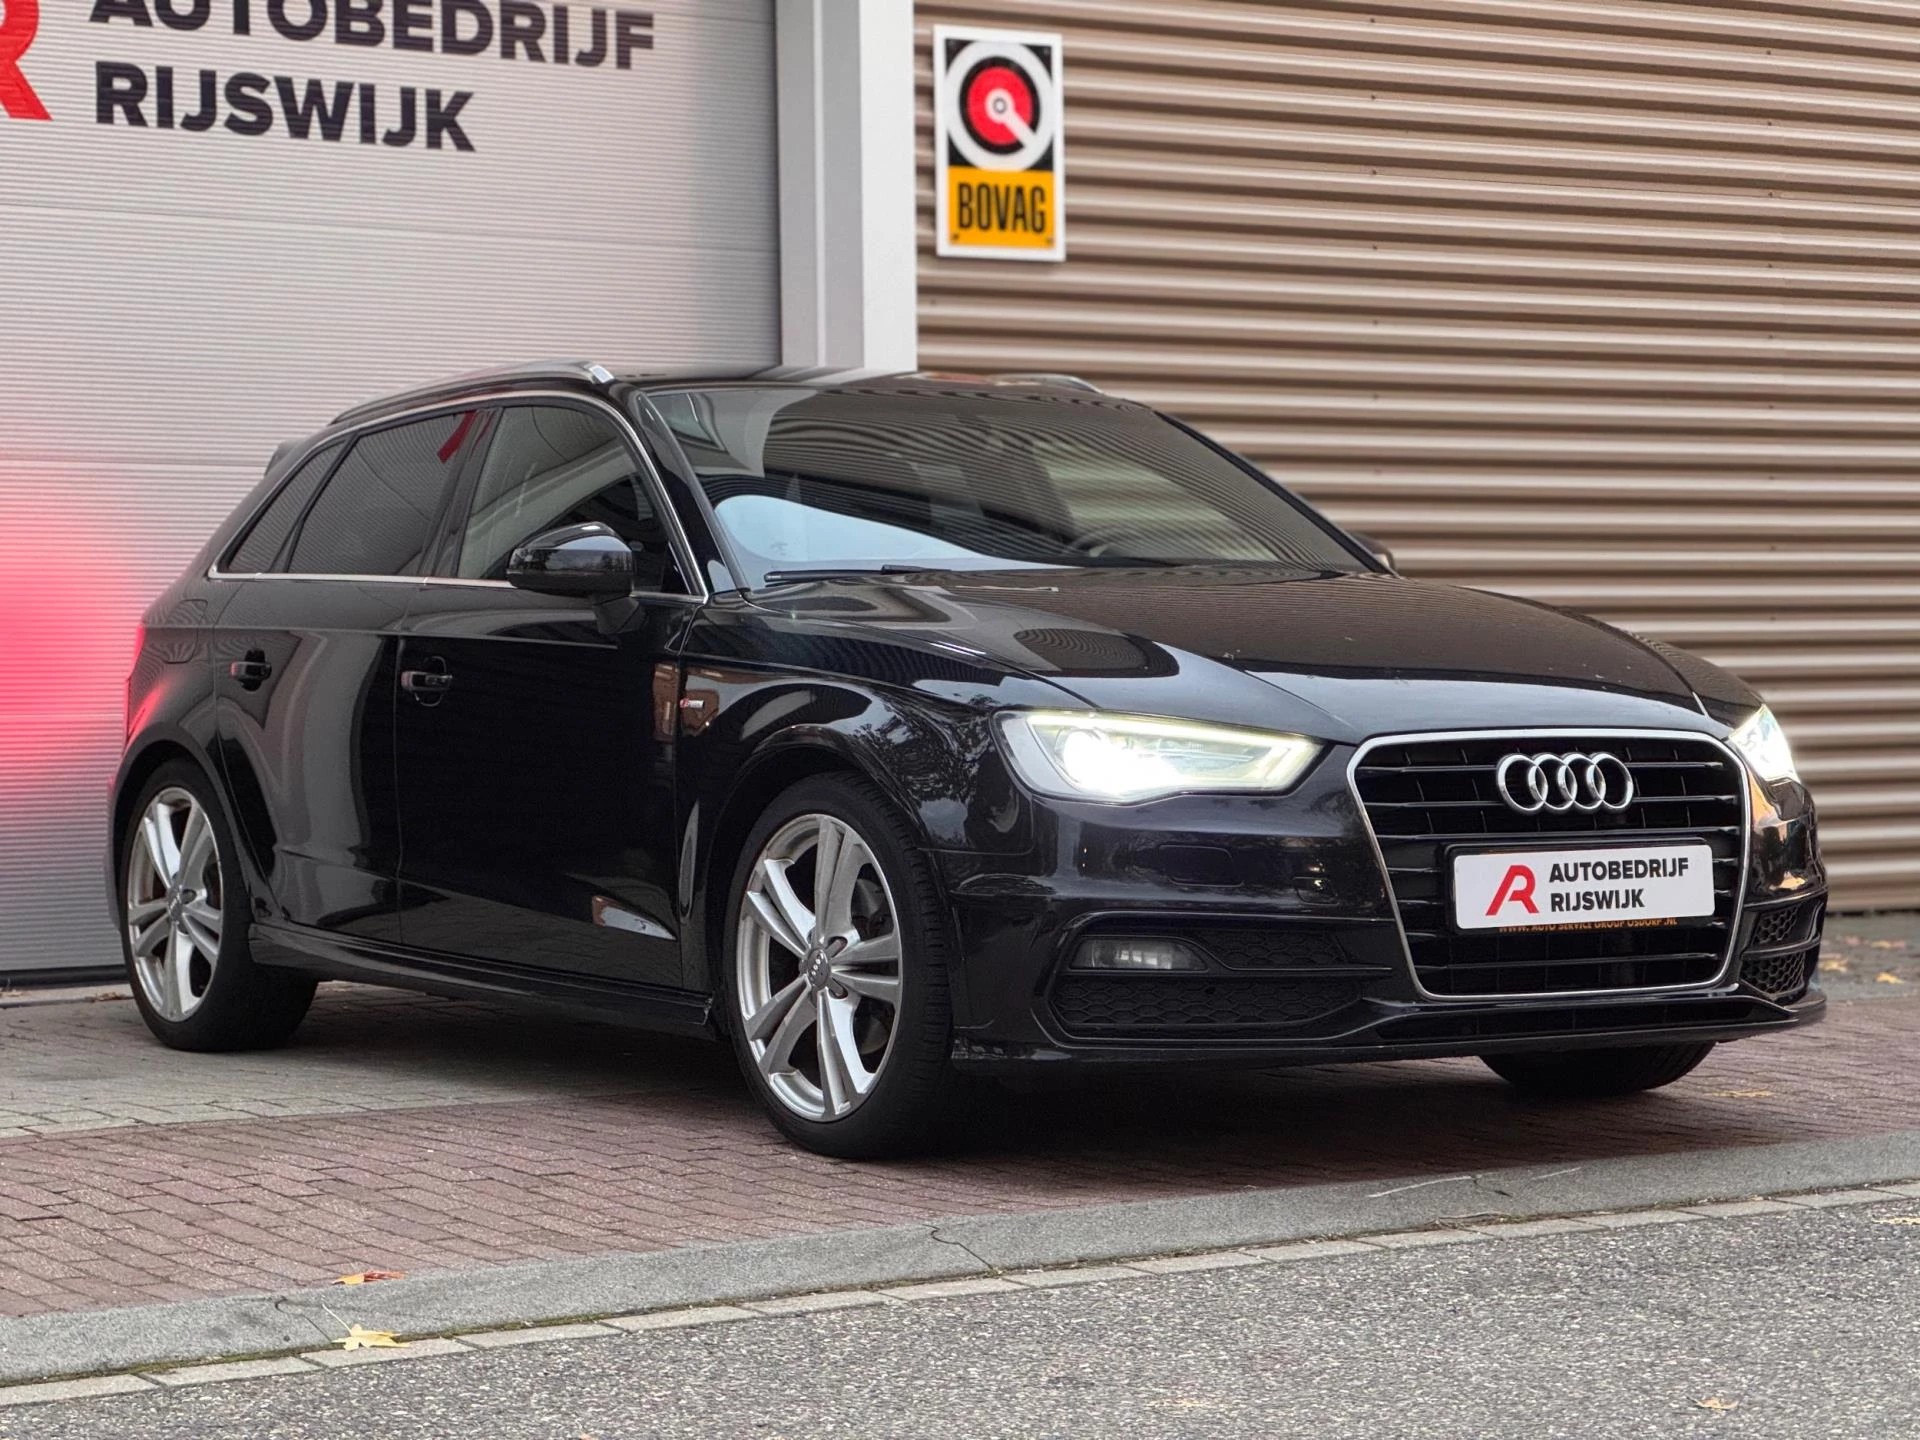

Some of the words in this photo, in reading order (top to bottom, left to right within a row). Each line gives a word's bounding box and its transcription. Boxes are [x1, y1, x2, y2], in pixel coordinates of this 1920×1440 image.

[94, 60, 476, 153] RIJSWIJK
[957, 182, 1046, 234] BOVAG
[1549, 857, 1689, 883] AUTOBEDRIJF
[1550, 888, 1646, 913] RIJSWIJK
